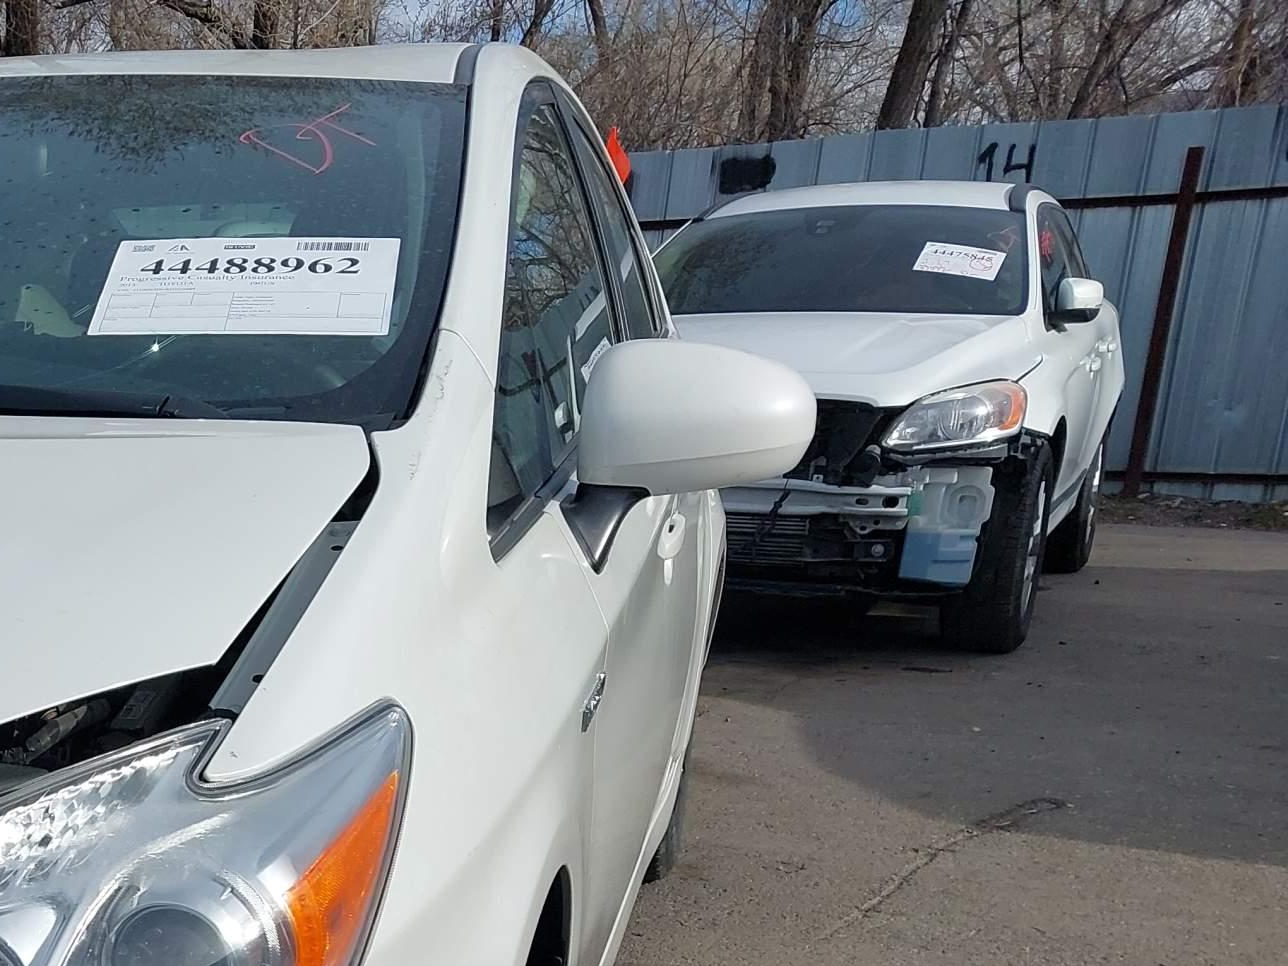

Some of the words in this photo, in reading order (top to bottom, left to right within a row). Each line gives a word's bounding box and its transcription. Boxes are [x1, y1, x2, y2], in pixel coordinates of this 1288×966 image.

[977, 142, 1037, 184] 14
[140, 256, 361, 275] 44488962
[187, 274, 235, 282] Casualty
